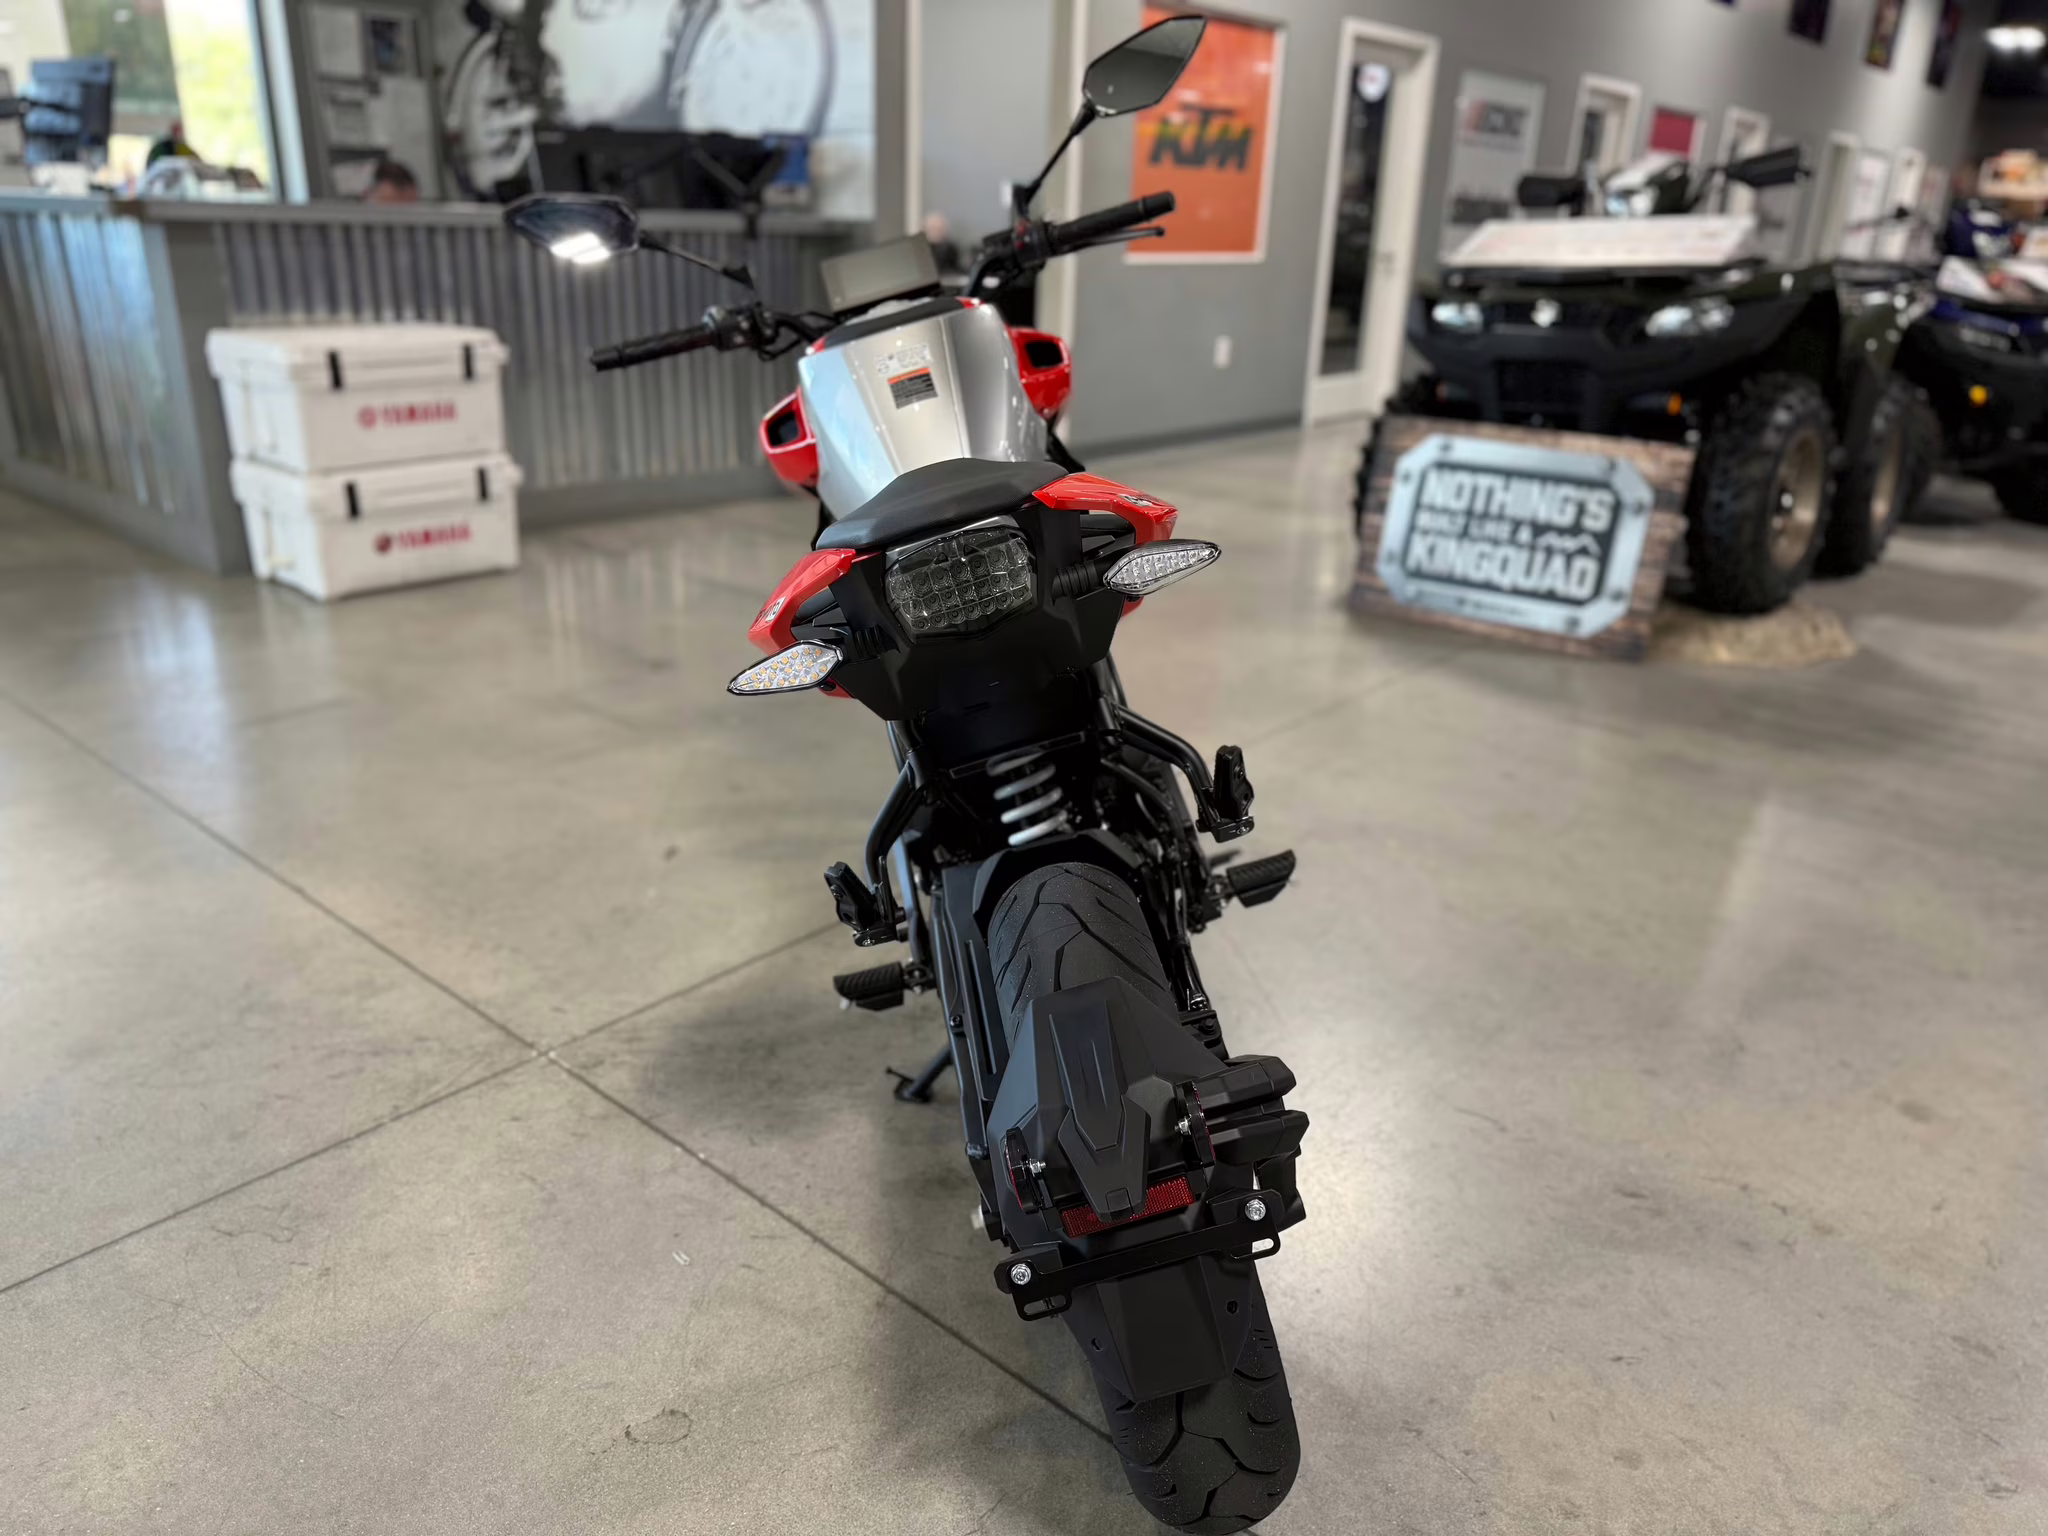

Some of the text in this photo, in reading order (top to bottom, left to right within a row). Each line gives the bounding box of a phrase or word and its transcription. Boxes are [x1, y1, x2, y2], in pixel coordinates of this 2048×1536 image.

[1148, 102, 1255, 172] KTM
[382, 402, 458, 425] YAMAHA
[1419, 468, 1614, 532] NOTHING'S
[397, 523, 472, 549] YAMAHA
[1515, 522, 1533, 545] A
[1405, 531, 1599, 601] KINGQUAD
